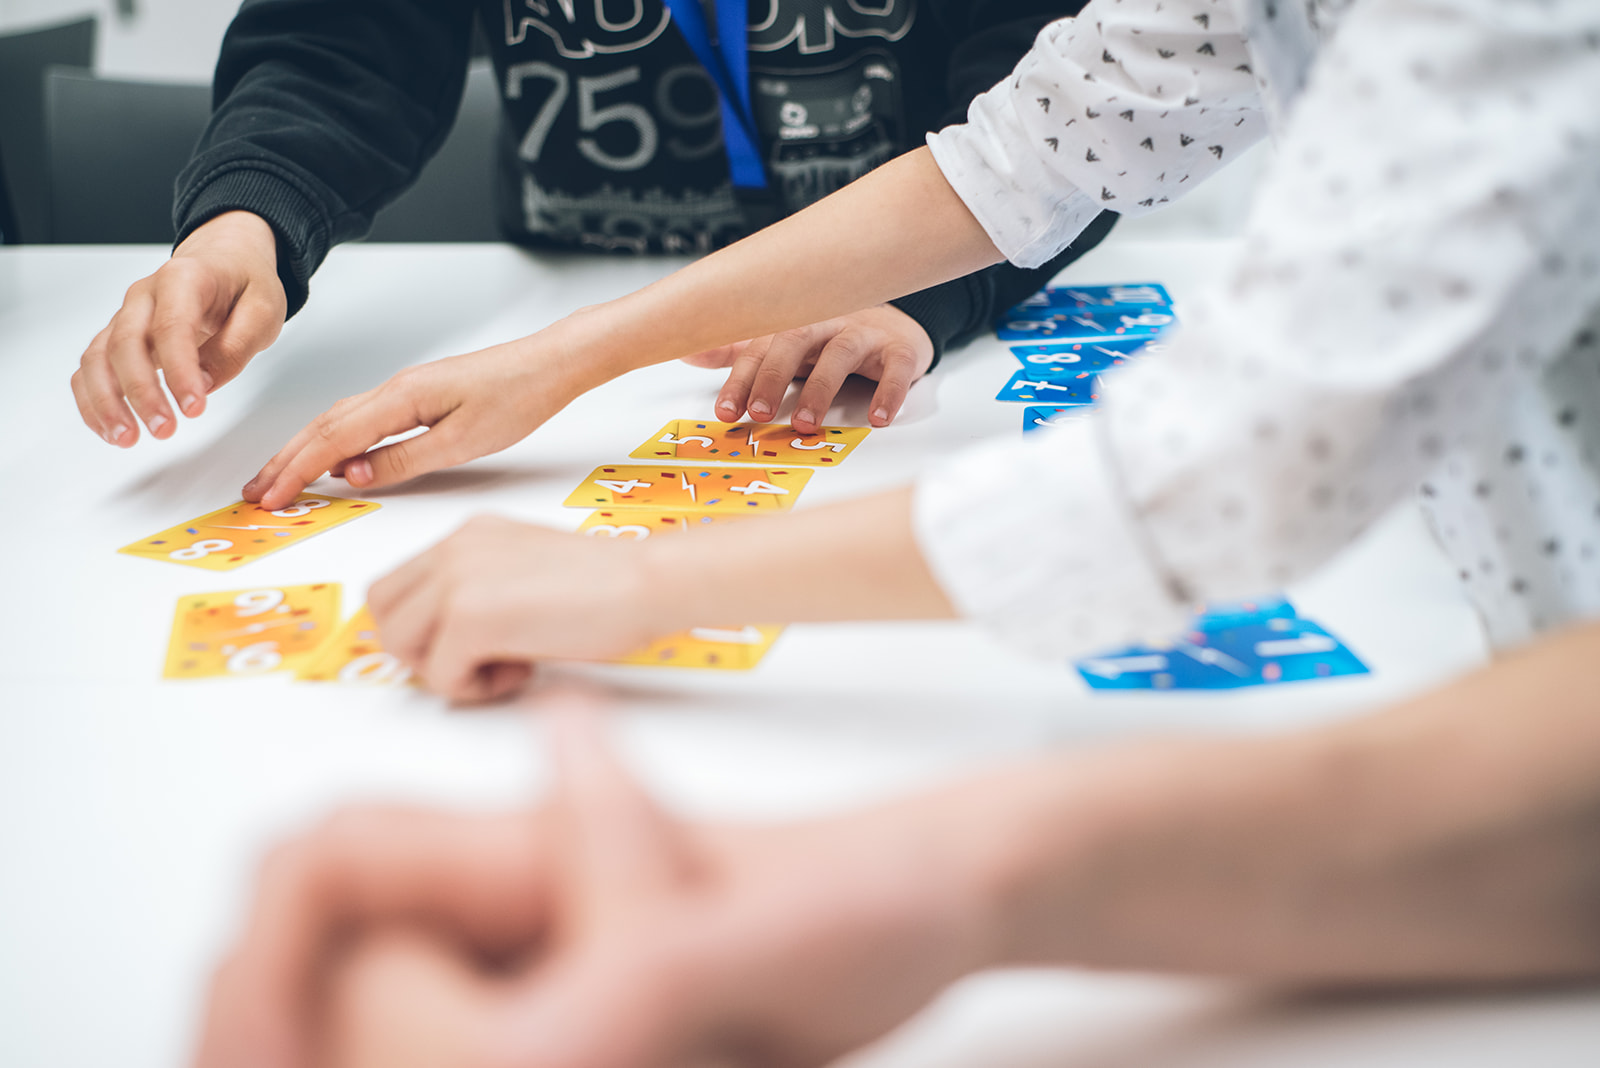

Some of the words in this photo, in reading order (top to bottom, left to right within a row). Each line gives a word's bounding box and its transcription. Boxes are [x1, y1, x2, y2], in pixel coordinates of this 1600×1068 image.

[1026, 352, 1081, 364] 8
[658, 433, 714, 448] 5
[790, 438, 847, 453] 5
[594, 479, 652, 493] 4
[730, 480, 790, 495] 4
[271, 499, 331, 518] 8
[168, 538, 234, 560] 8
